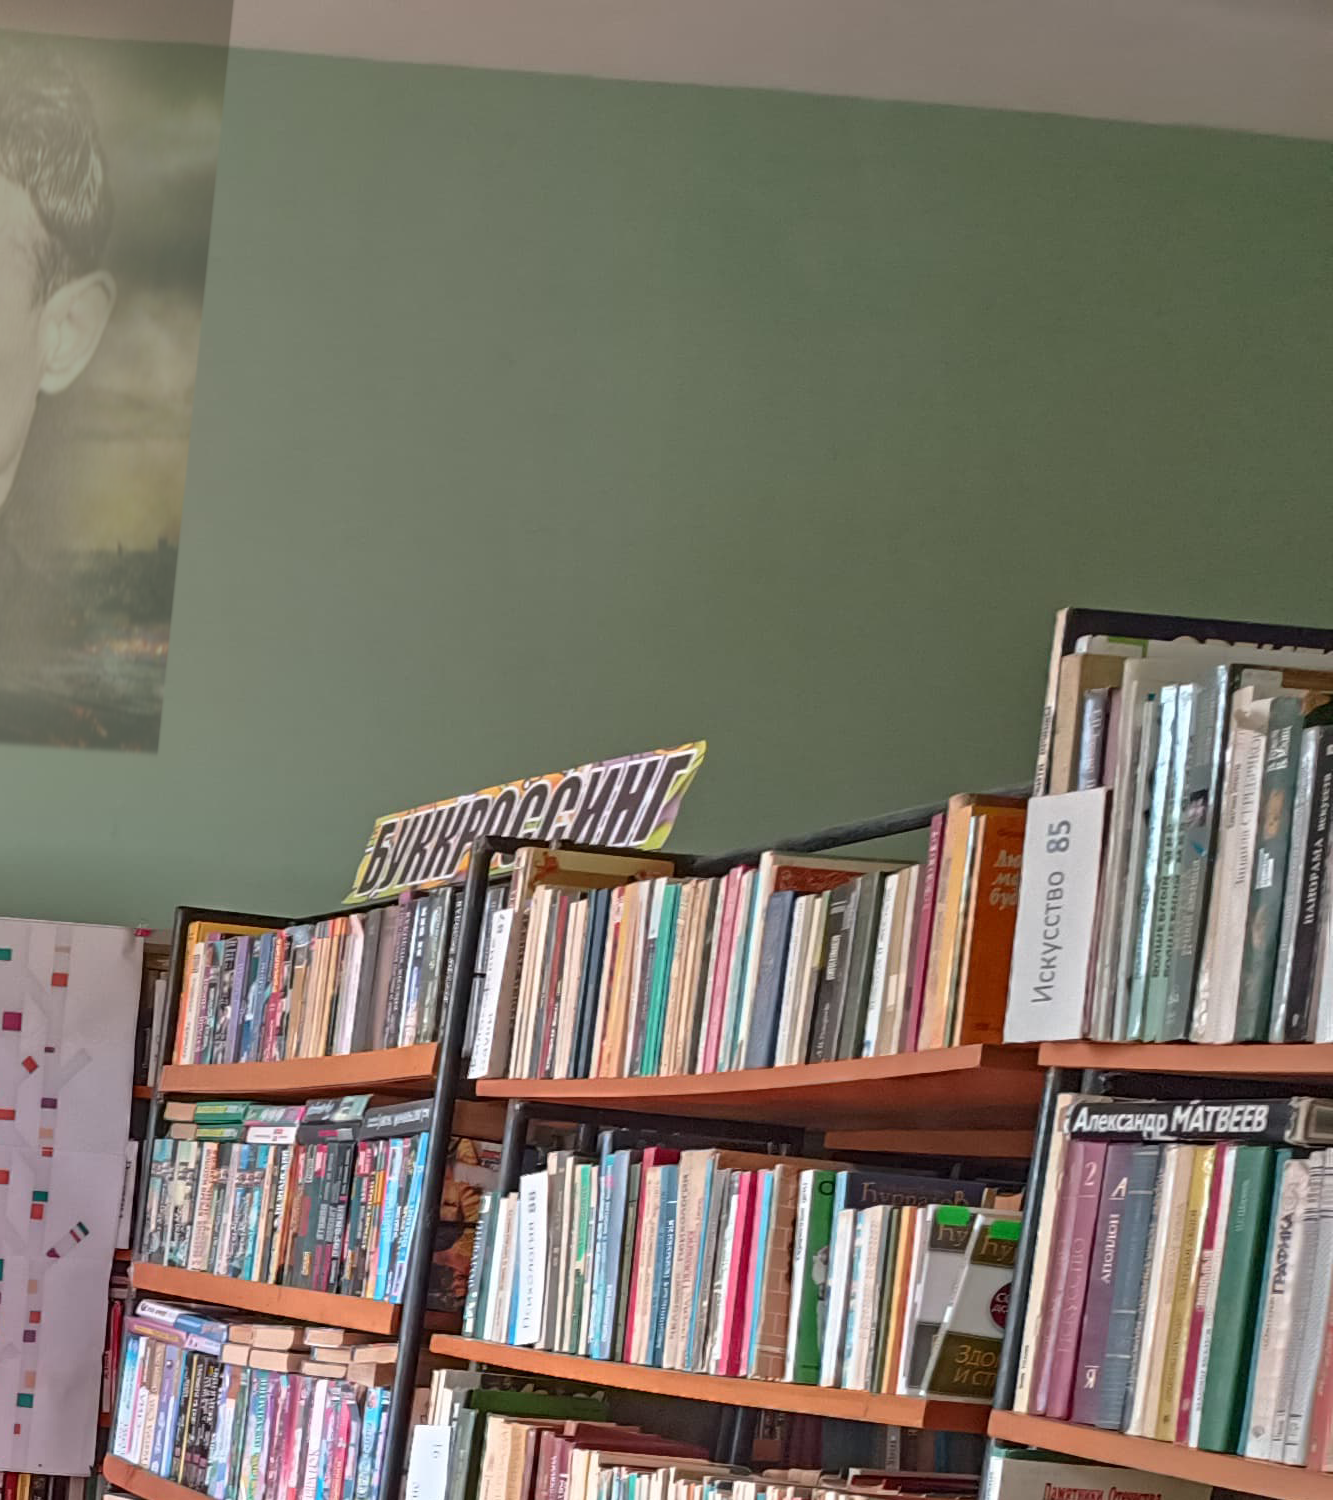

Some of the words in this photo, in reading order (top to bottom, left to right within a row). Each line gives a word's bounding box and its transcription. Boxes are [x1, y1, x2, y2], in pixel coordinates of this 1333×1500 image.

[1045, 819, 1071, 854] 85
[1031, 868, 1065, 1004] Искусство
[1072, 1107, 1167, 1136] Александр
[1171, 1100, 1268, 1133] МАТВЕЕВ
[514, 1221, 543, 1329] Психология
[1101, 1213, 1120, 1283] АПОЛЛОН
[1270, 1211, 1294, 1296] ГРАФИКА
